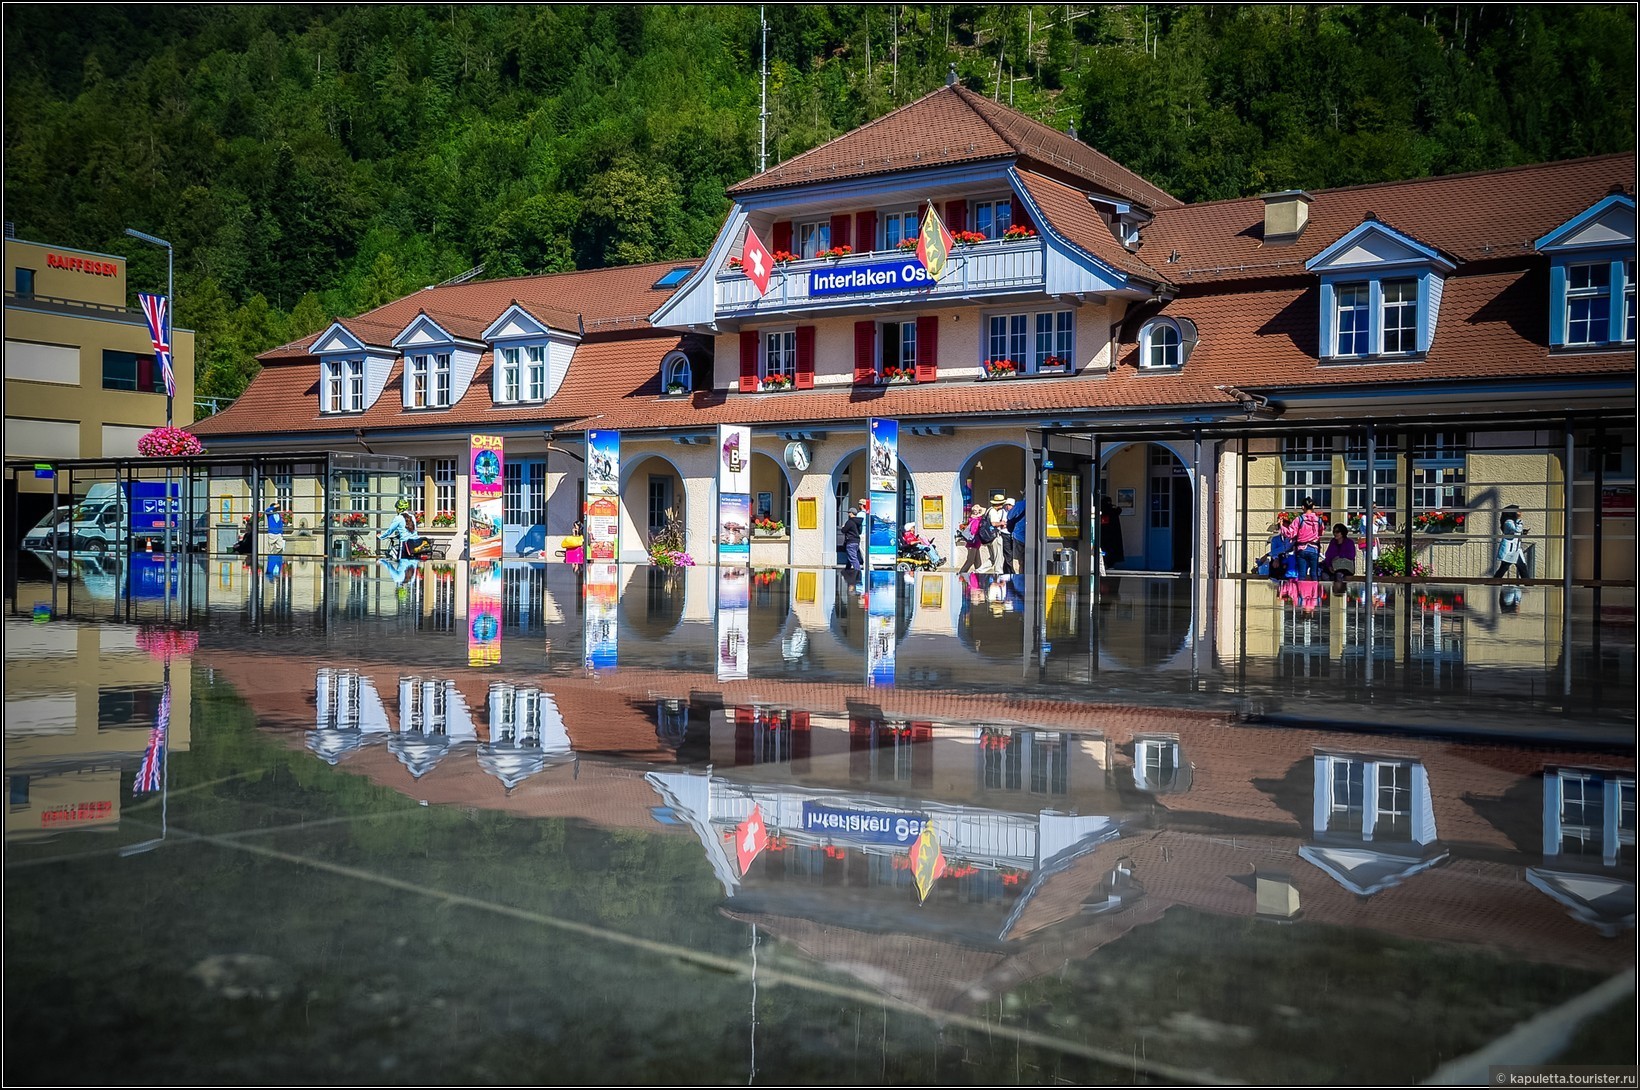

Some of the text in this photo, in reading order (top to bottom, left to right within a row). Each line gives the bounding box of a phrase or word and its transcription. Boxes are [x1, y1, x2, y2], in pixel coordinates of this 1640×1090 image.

[47, 253, 118, 277] RAIFFEISEN
[813, 264, 932, 291] Interlaken Ost
[471, 434, 502, 447] OHA
